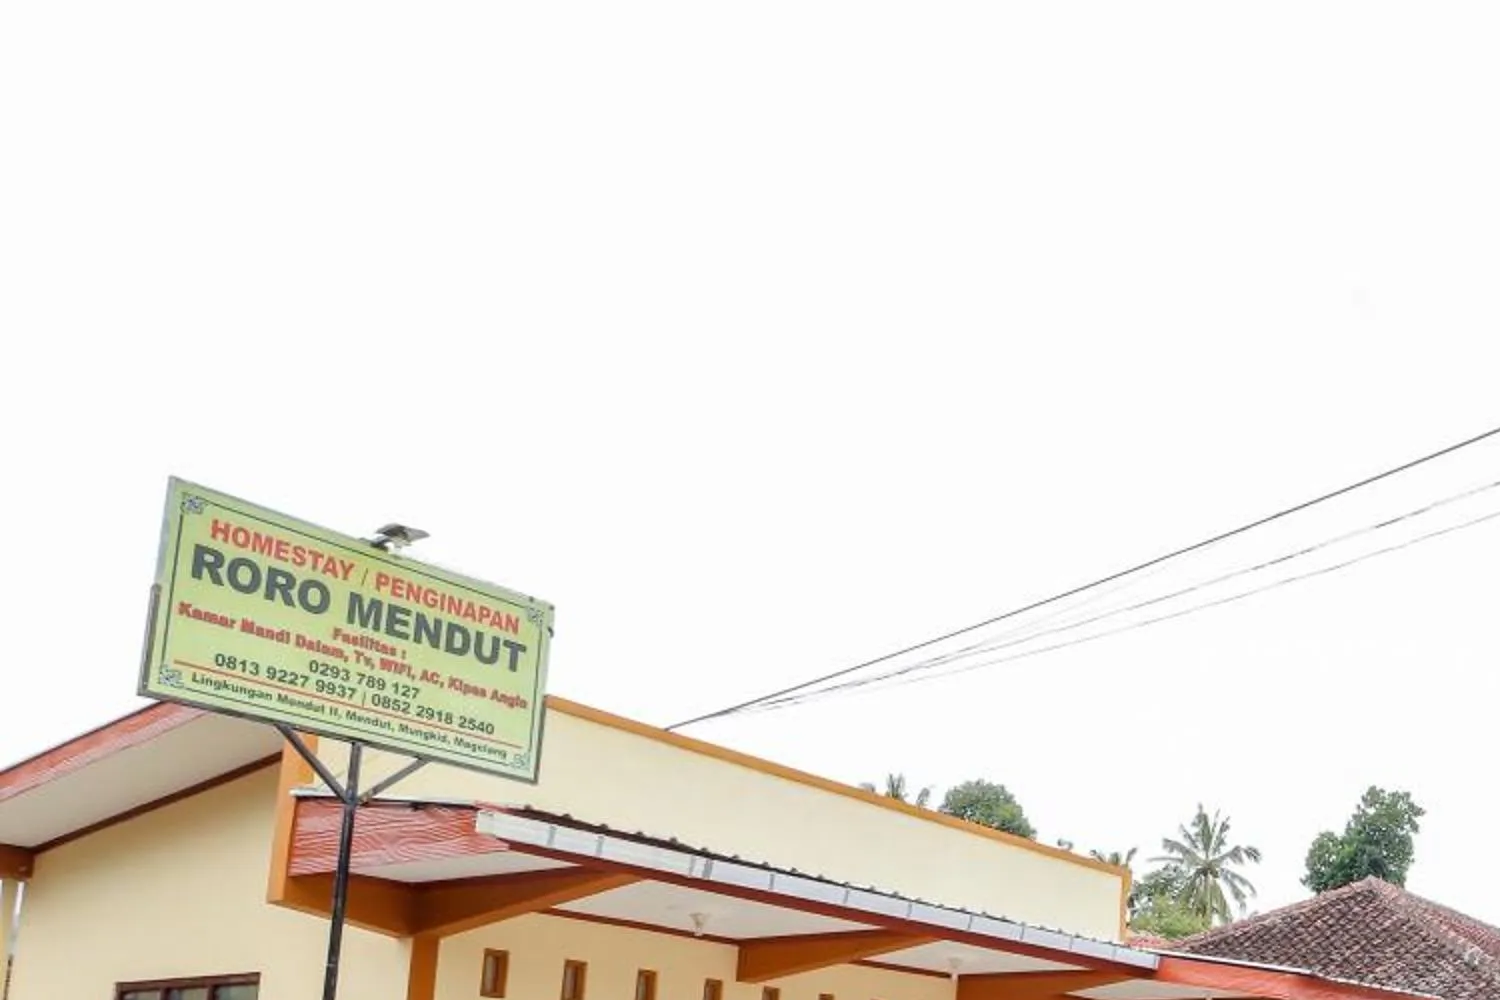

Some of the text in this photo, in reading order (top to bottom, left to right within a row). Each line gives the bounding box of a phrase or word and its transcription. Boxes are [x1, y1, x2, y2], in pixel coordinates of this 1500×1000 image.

[191, 544, 527, 672] RORO MENDUT
[211, 519, 354, 581] HOMESTAY
[375, 571, 520, 635] PENGINAPAN
[178, 602, 237, 628] Kamar
[240, 618, 291, 645] Mandi
[420, 669, 444, 688] AC,
[192, 672, 273, 701] Lingkungan
[309, 659, 420, 699] 0293 789 127
[215, 653, 260, 676] 0813
[266, 666, 310, 687] 9227
[315, 679, 357, 700] 9937
[371, 693, 411, 714] 0852
[416, 705, 453, 725] 2918
[458, 715, 495, 735] 2540
